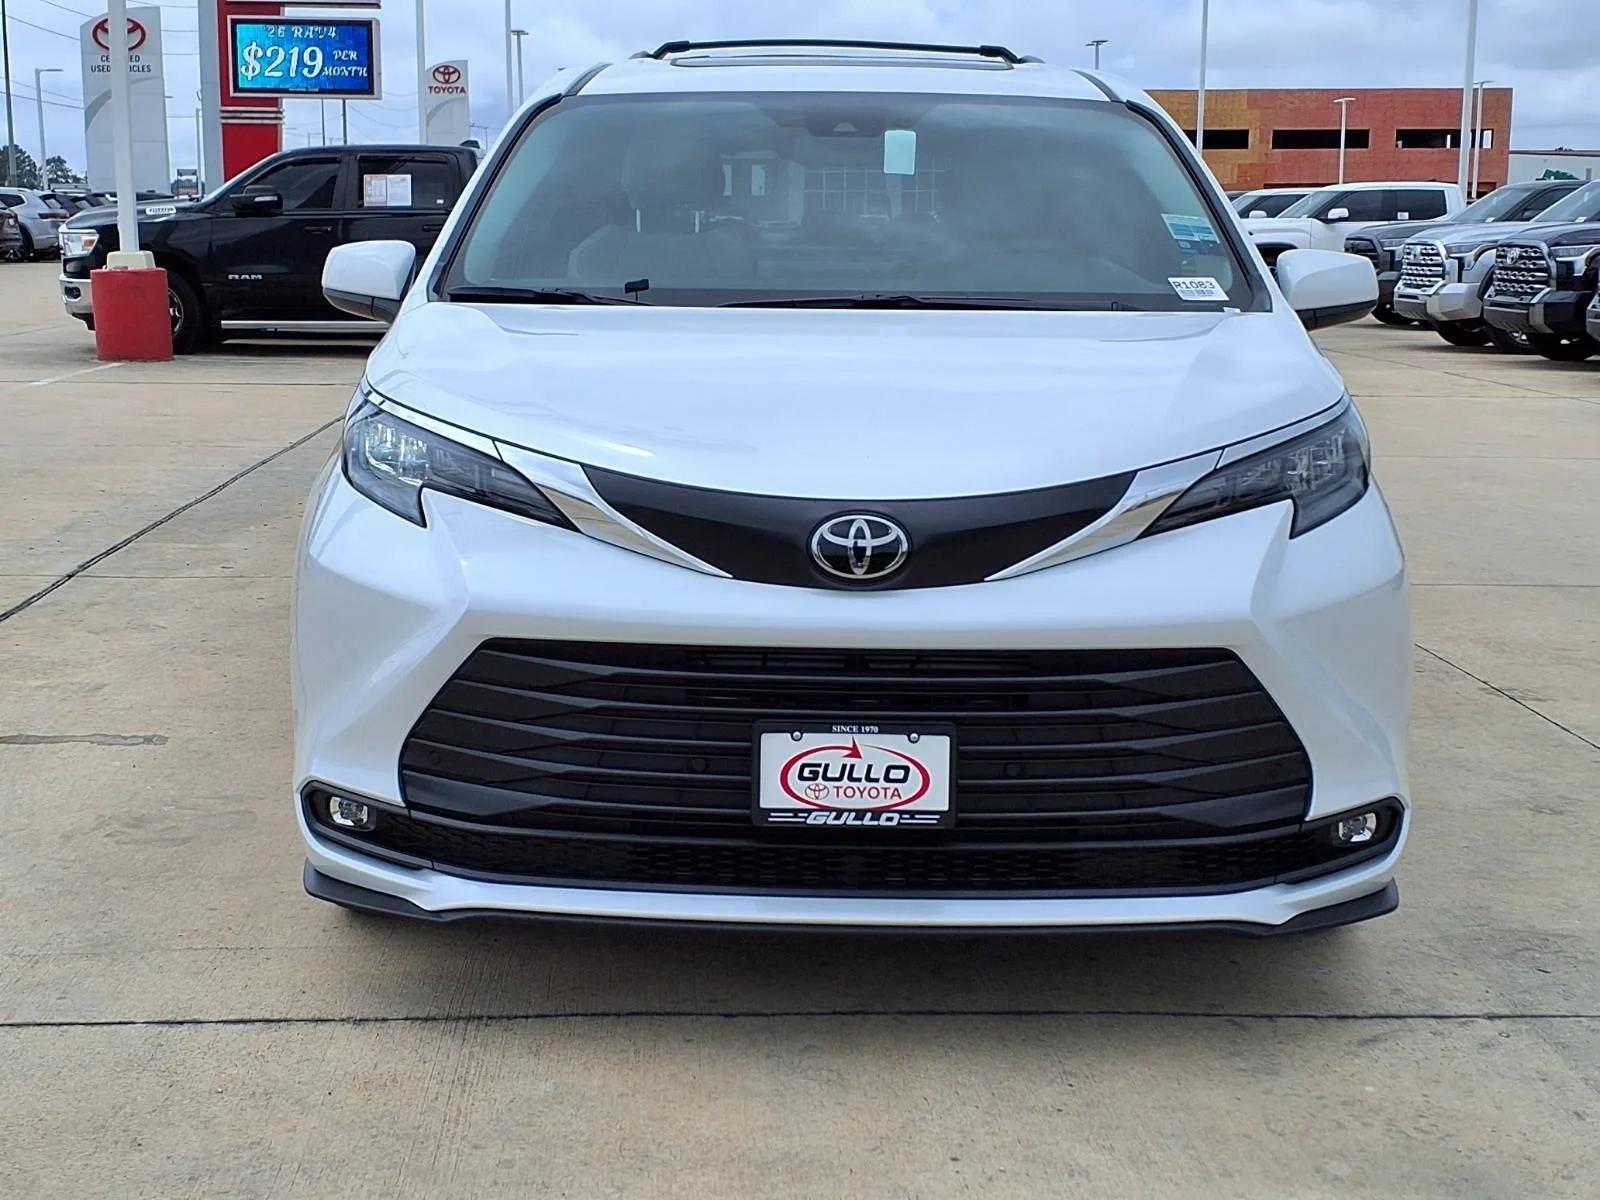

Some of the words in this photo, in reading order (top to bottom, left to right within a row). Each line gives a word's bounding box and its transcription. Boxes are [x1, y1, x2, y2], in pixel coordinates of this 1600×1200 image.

[291, 26, 337, 39] RAV4
[240, 41, 324, 80] $219
[333, 50, 358, 61] PER
[129, 64, 152, 73] ICLES
[322, 66, 368, 78] MONTH
[428, 85, 467, 94] TOYOTA
[1172, 281, 1216, 289] R1083
[831, 725, 860, 733] SINCE
[861, 725, 879, 733] 1970
[797, 762, 911, 783] GULLO
[833, 785, 902, 800] TOYOTA
[806, 811, 900, 826] GULLO
